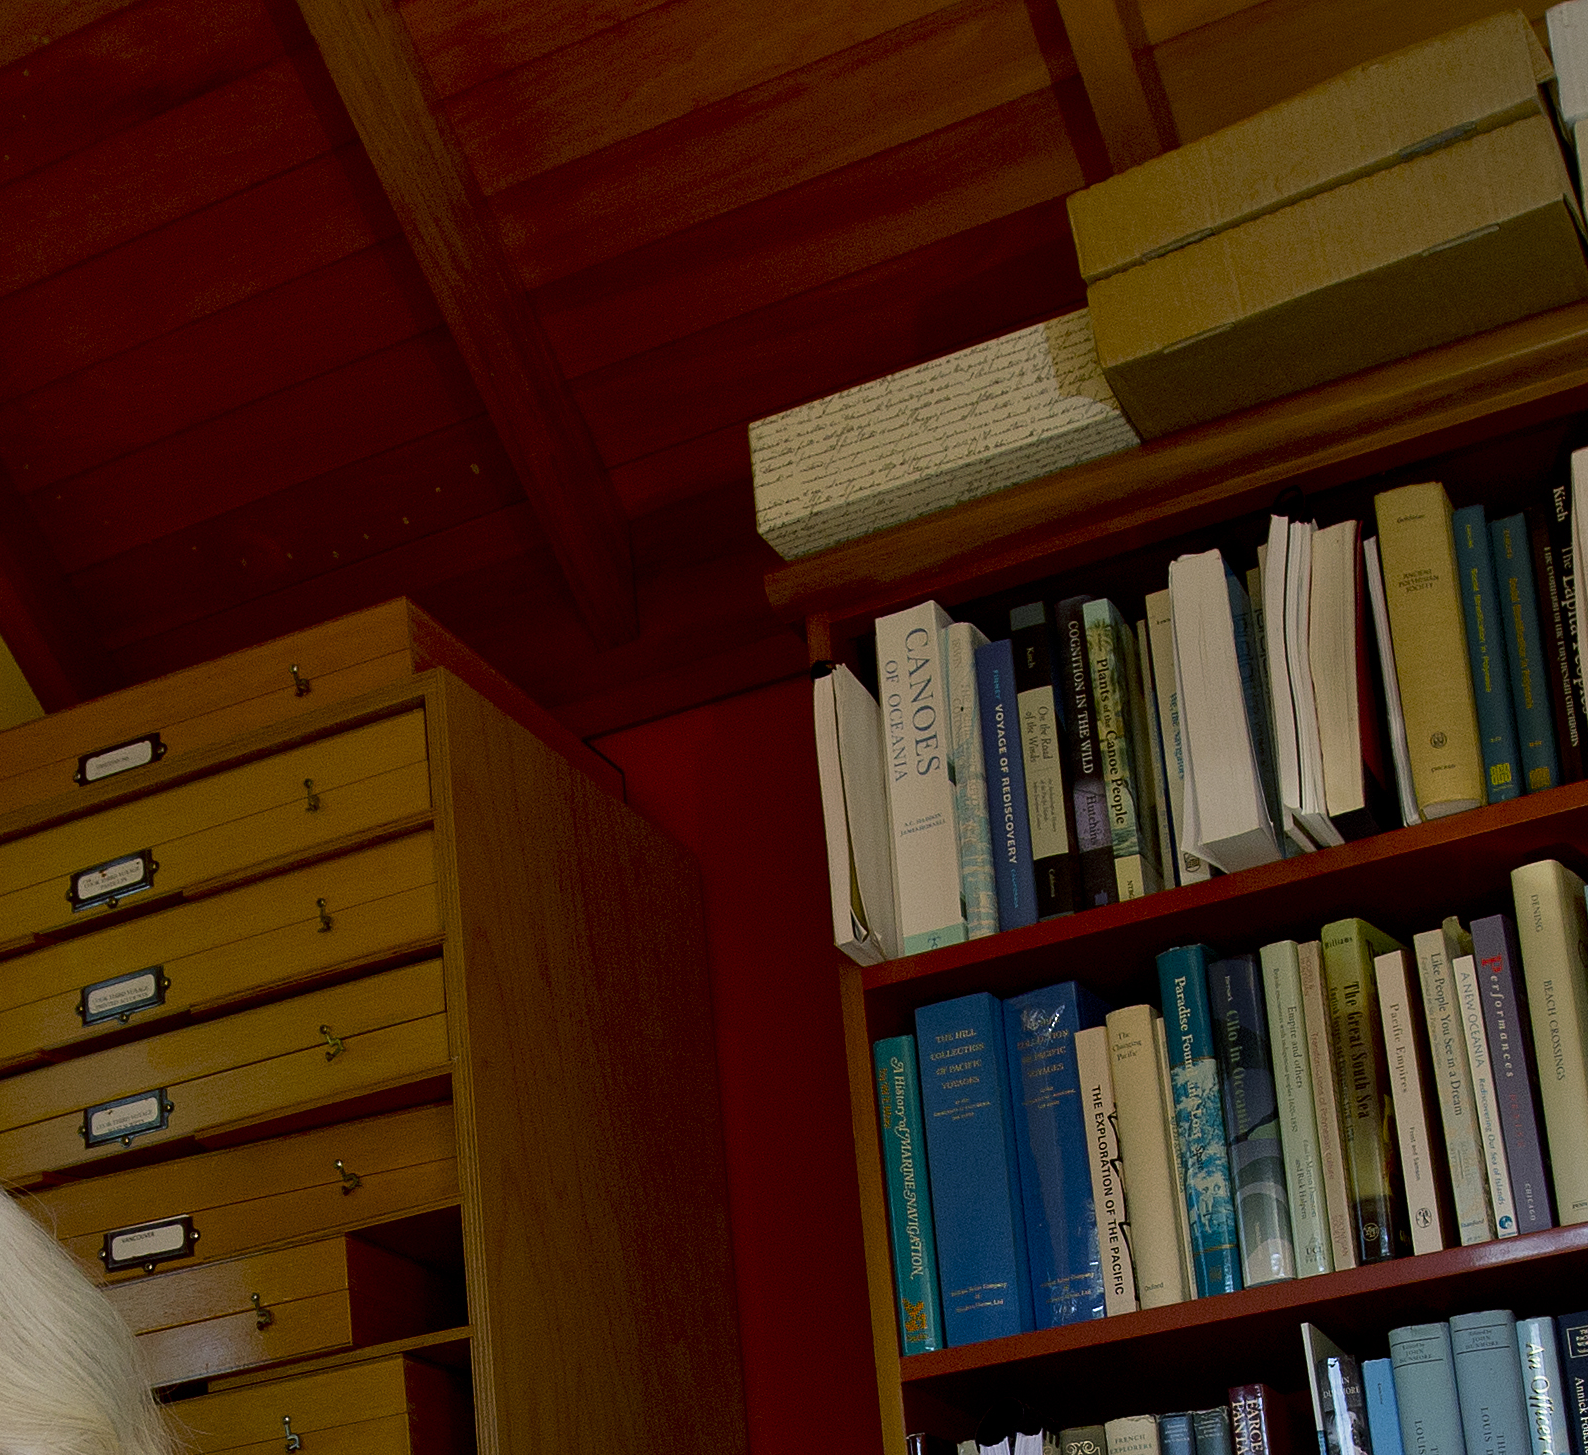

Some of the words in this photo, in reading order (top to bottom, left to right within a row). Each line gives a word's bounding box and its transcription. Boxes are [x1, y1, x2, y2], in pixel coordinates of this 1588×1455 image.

[1552, 486, 1569, 522] Kirch
[883, 660, 900, 684] OF
[1067, 620, 1085, 692] COGNITION
[1095, 657, 1112, 703] Plants
[904, 628, 941, 776] CANOES
[1075, 694, 1088, 707] IN
[1103, 704, 1111, 713] of
[887, 694, 908, 782] OCEANIA
[994, 704, 1007, 754] VOYAGE
[1076, 711, 1091, 738] THE
[1104, 714, 1113, 728] the
[999, 757, 1010, 773] OF
[1078, 740, 1094, 774] WILD
[1104, 731, 1124, 775] Canoe
[1111, 778, 1128, 824] People
[1000, 776, 1018, 864] REDISCOVERY
[1543, 980, 1557, 1016] BEACH
[1548, 1019, 1566, 1081] CROSSINGS
[1091, 1085, 1101, 1109] THE
[1094, 1113, 1112, 1196] EXPLORATION
[1105, 1200, 1116, 1217] OF
[1108, 1221, 1119, 1243] THE
[1111, 1247, 1125, 1295] PACIFIC
[1526, 1343, 1545, 1370] An
[1530, 1375, 1555, 1443] Officer
